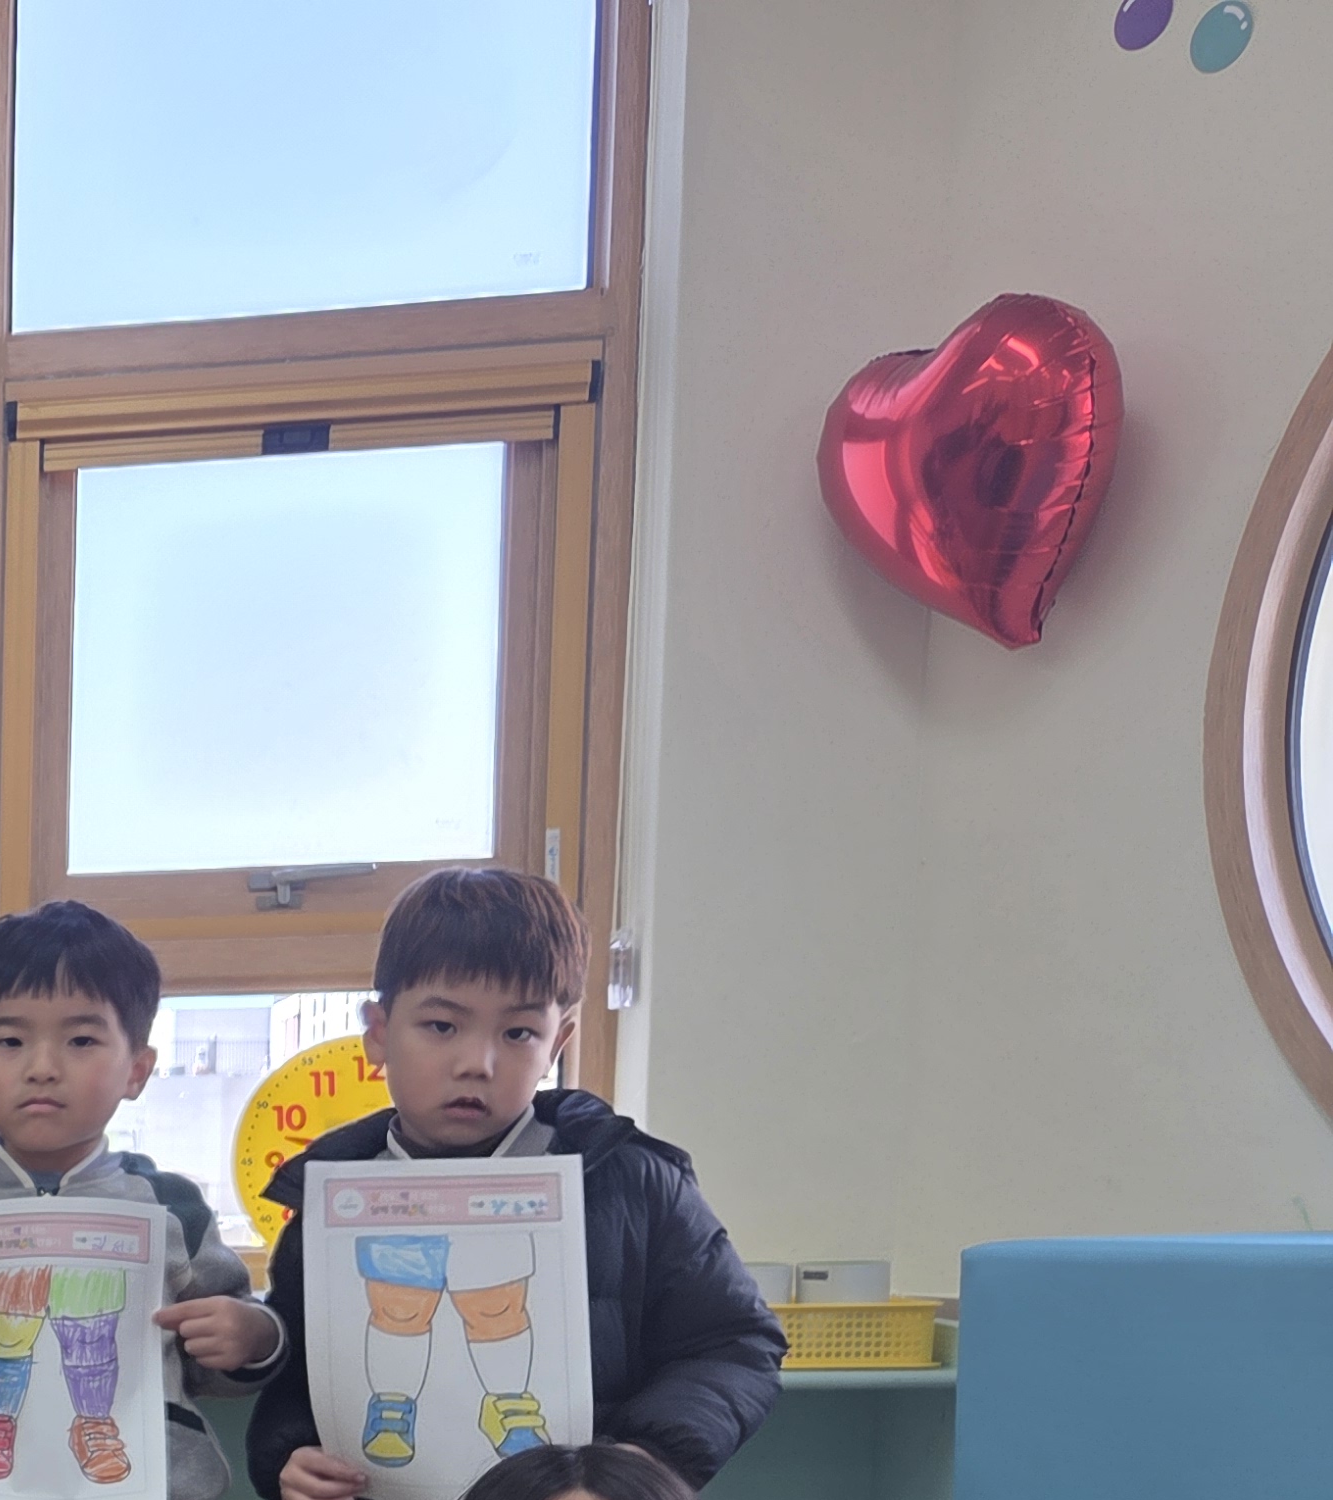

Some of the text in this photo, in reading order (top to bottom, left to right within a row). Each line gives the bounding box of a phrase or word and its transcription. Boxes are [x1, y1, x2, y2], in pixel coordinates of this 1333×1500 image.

[309, 1071, 336, 1098] 11
[256, 1101, 269, 1110] 50
[272, 1104, 307, 1131] 10
